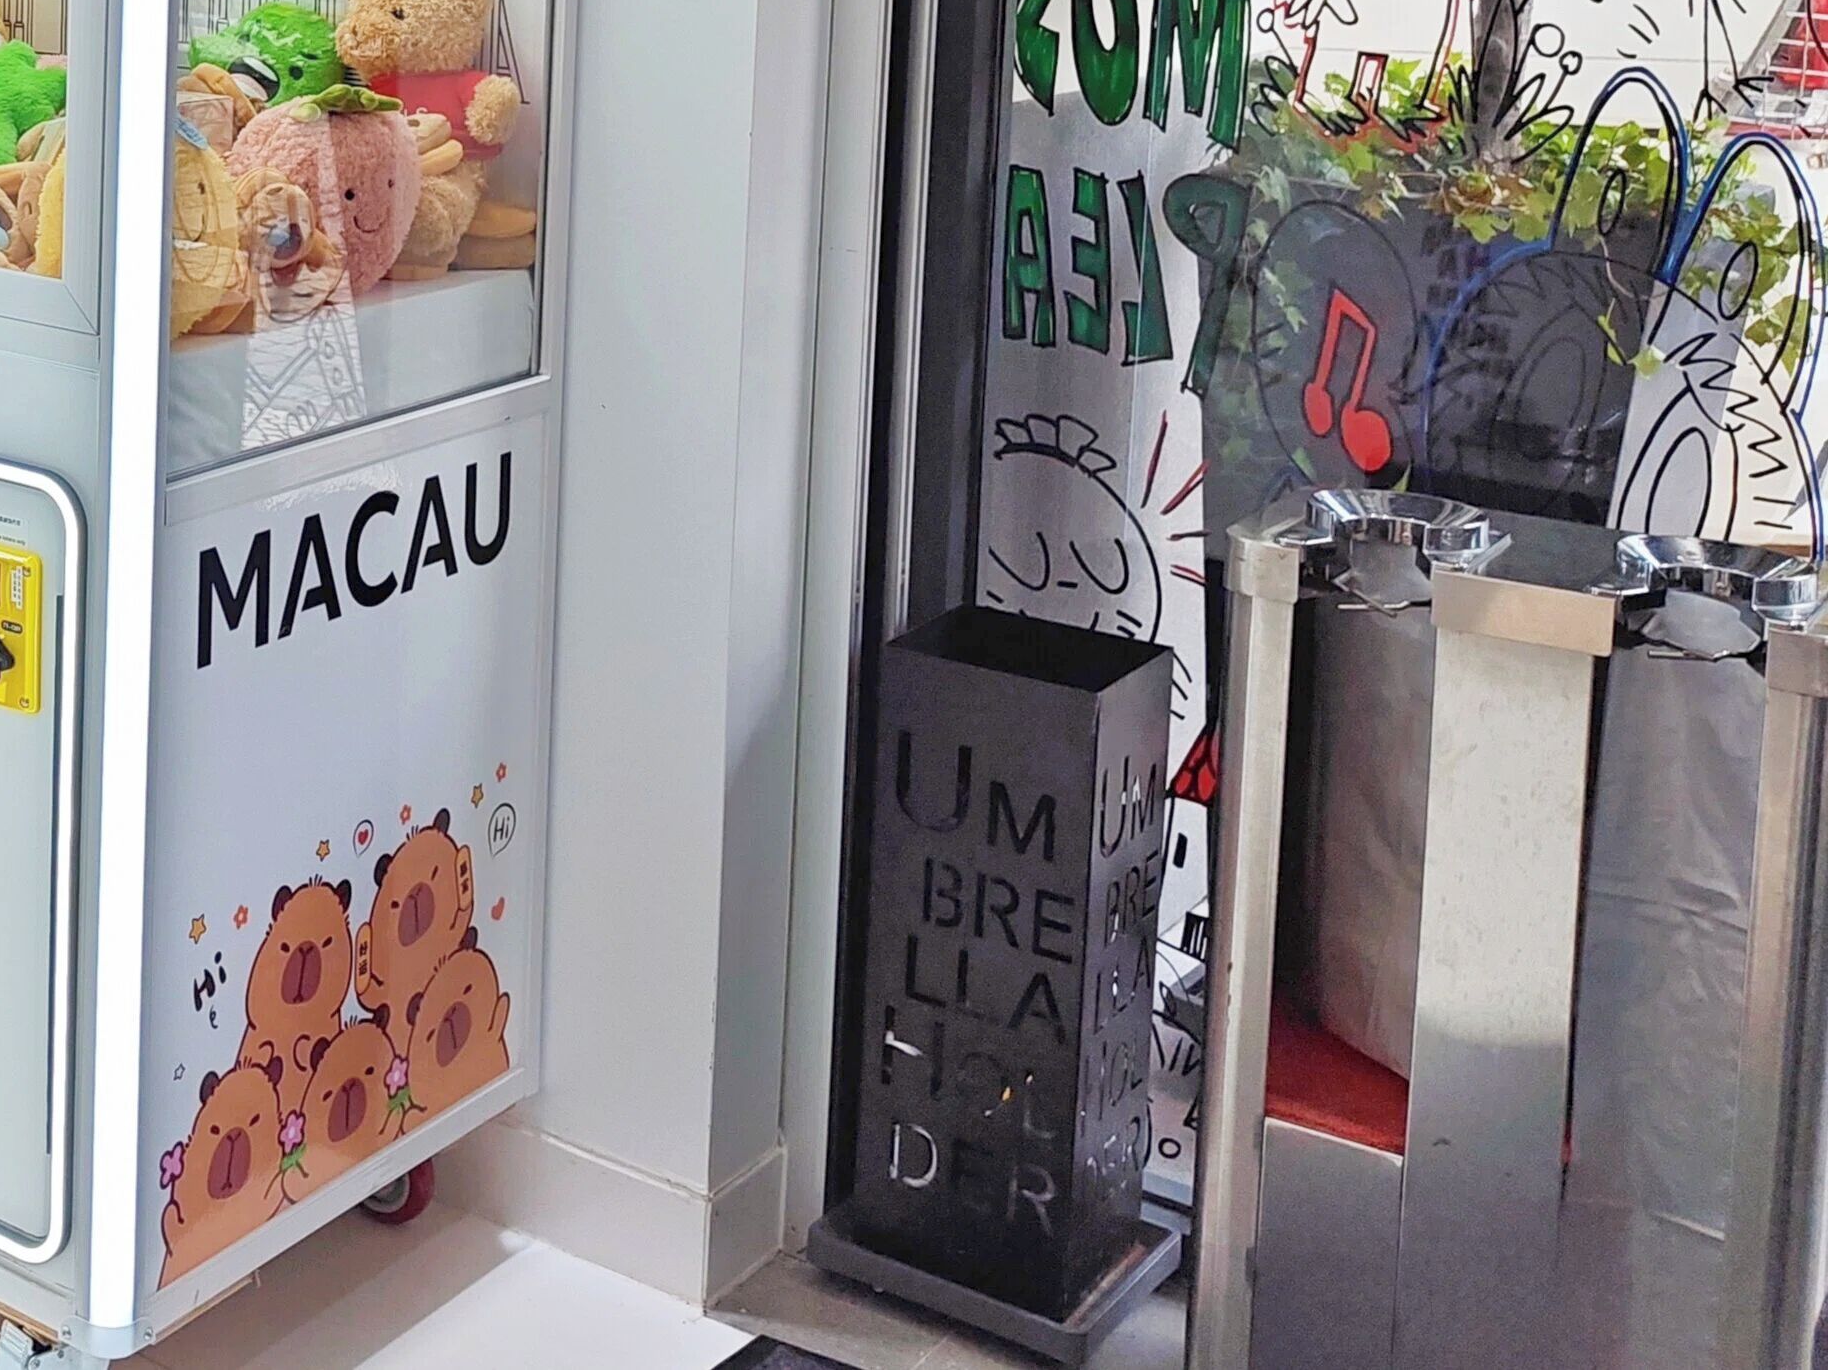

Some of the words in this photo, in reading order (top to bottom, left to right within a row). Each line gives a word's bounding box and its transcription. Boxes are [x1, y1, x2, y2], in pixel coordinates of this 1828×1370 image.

[196, 451, 513, 670] MACAU
[493, 815, 511, 843] Hi
[895, 729, 1057, 862] UM
[1099, 754, 1157, 859] UM
[922, 856, 1075, 963] BRE
[1104, 848, 1159, 948] BRE
[193, 951, 227, 1012] Hi
[905, 933, 1068, 1044] LLA
[1093, 933, 1153, 1036] LLA
